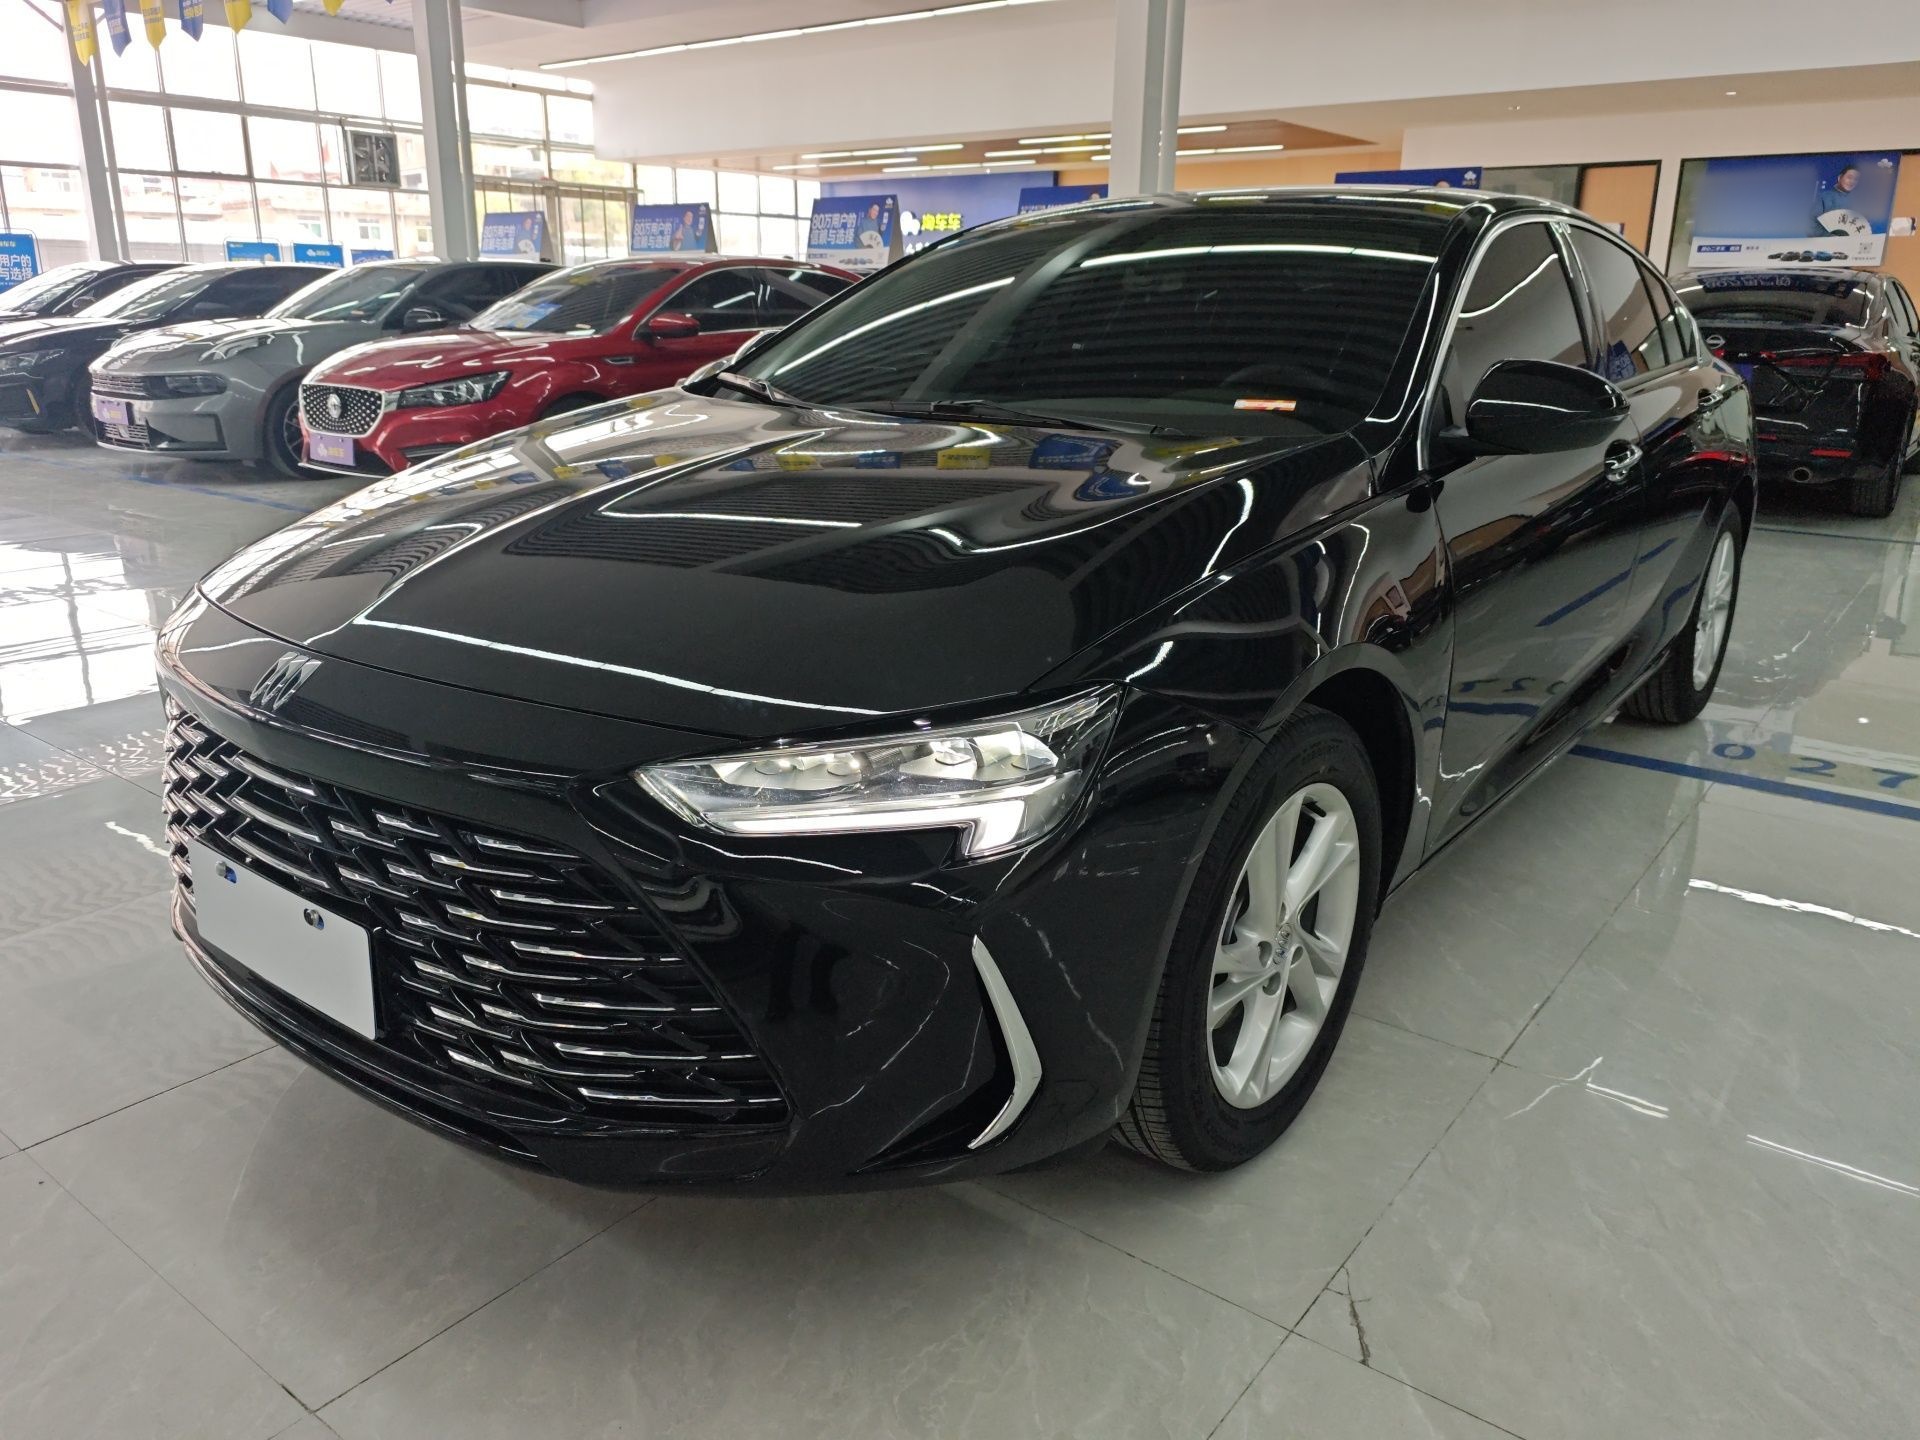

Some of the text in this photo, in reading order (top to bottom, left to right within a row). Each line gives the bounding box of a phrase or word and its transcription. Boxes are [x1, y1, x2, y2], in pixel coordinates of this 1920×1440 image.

[811, 213, 857, 229] 80万用户的
[1712, 743, 1918, 789] 027
